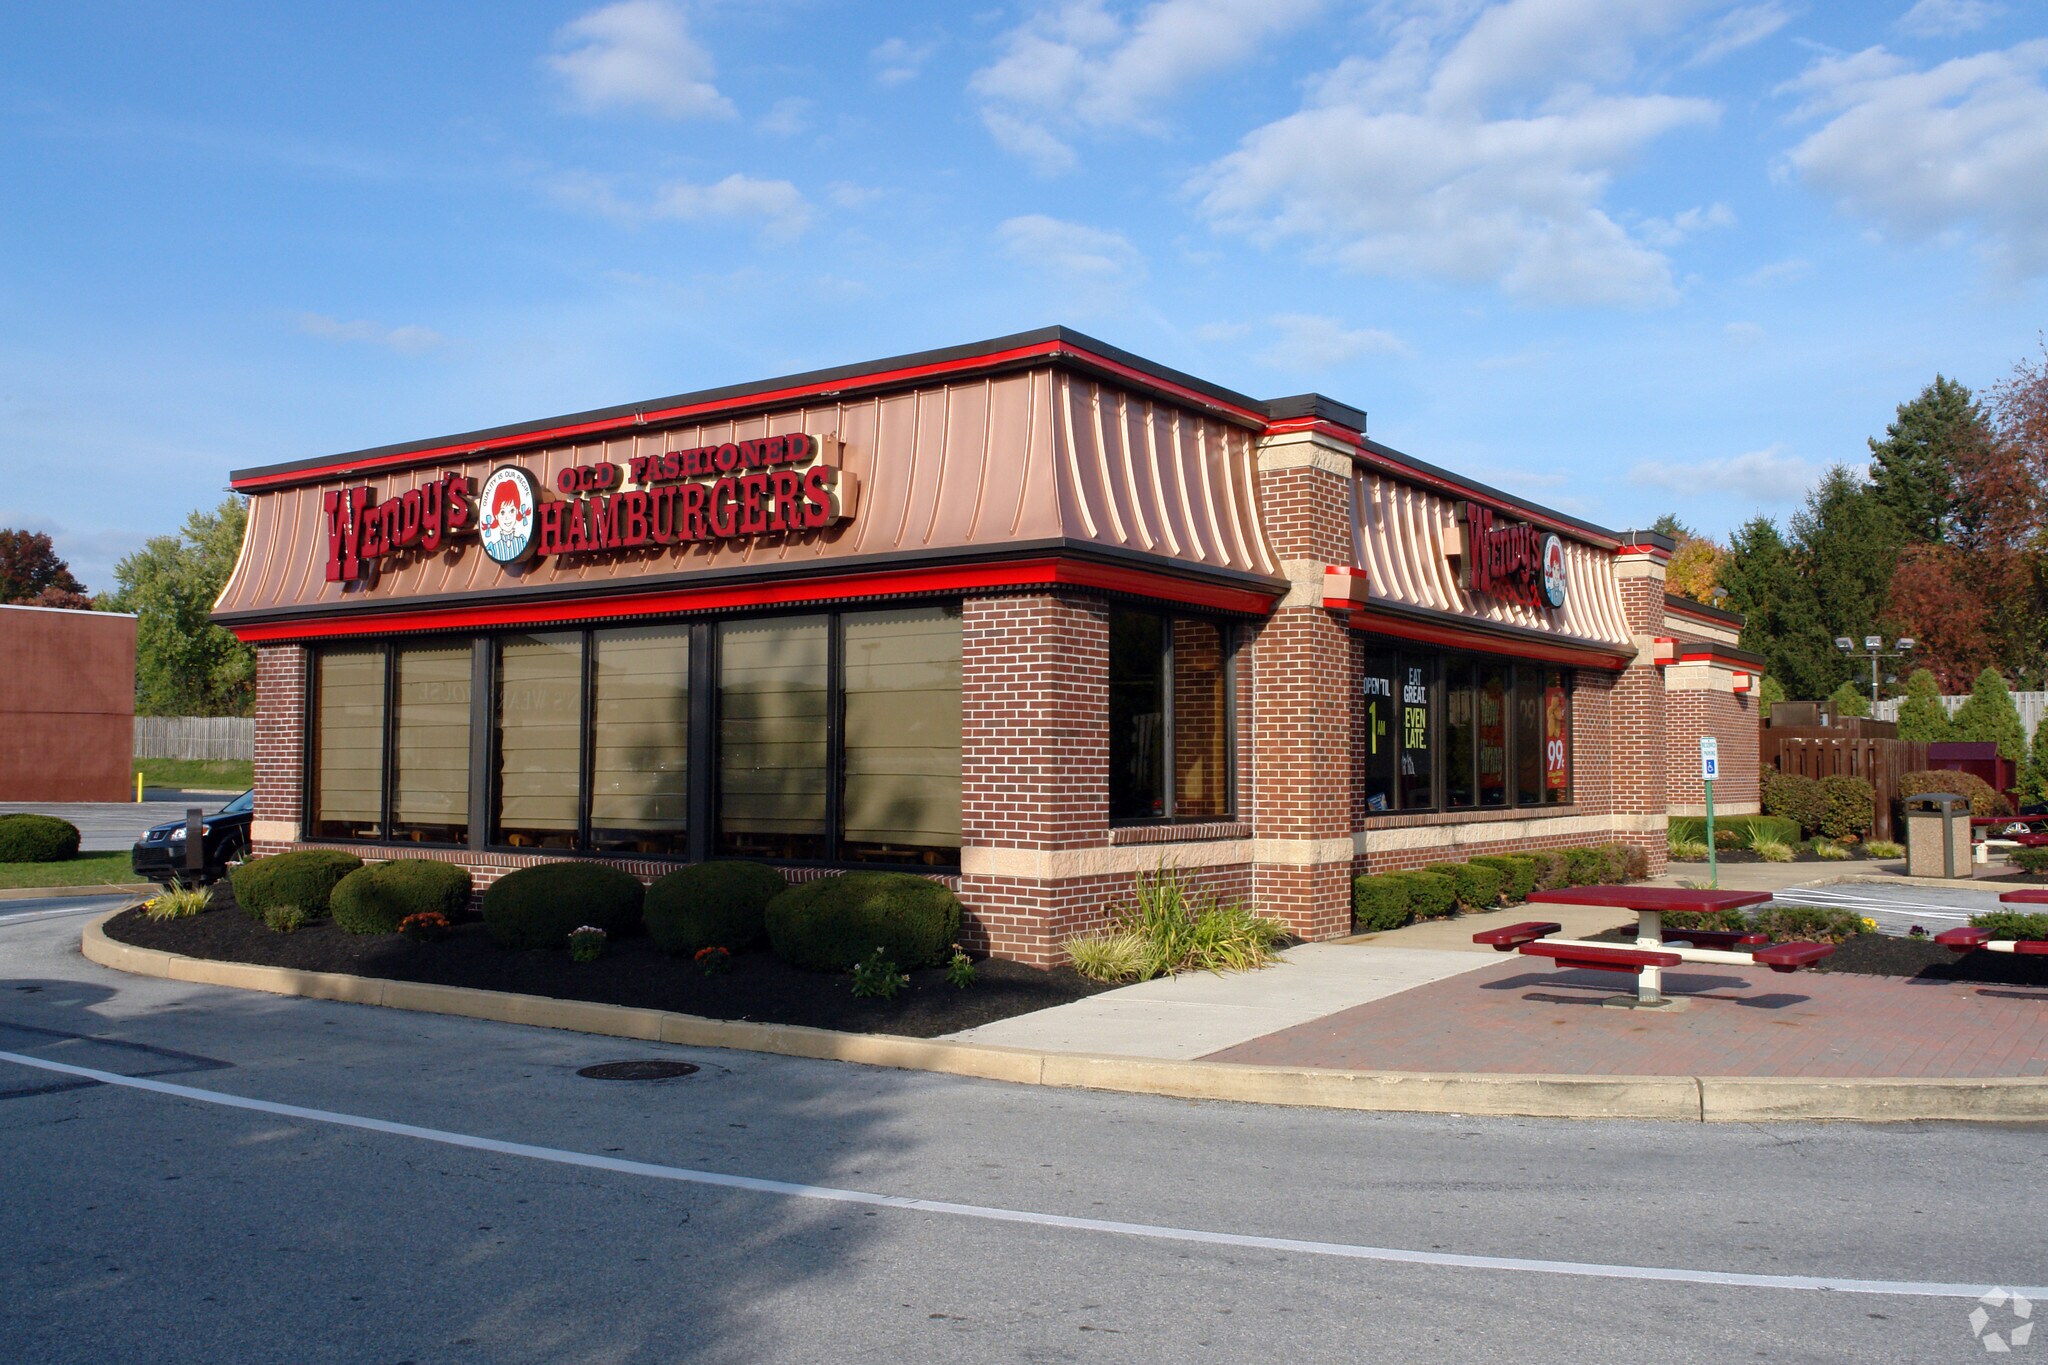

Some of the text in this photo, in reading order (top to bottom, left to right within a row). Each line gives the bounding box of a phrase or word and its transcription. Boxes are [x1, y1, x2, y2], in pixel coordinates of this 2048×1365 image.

[557, 432, 811, 493] OLD FASHIONED
[482, 478, 497, 507] QUALITY
[504, 470, 516, 478] OUR
[516, 474, 531, 498] RECIPE
[537, 465, 831, 556] HAMBURGERS
[1364, 676, 1379, 695] OPEN
[1409, 667, 1422, 685] EAT
[1404, 684, 1427, 704] GREAT.
[1369, 701, 1377, 755] 1
[1405, 707, 1426, 728] EVEN
[1405, 728, 1427, 749] LATE.
